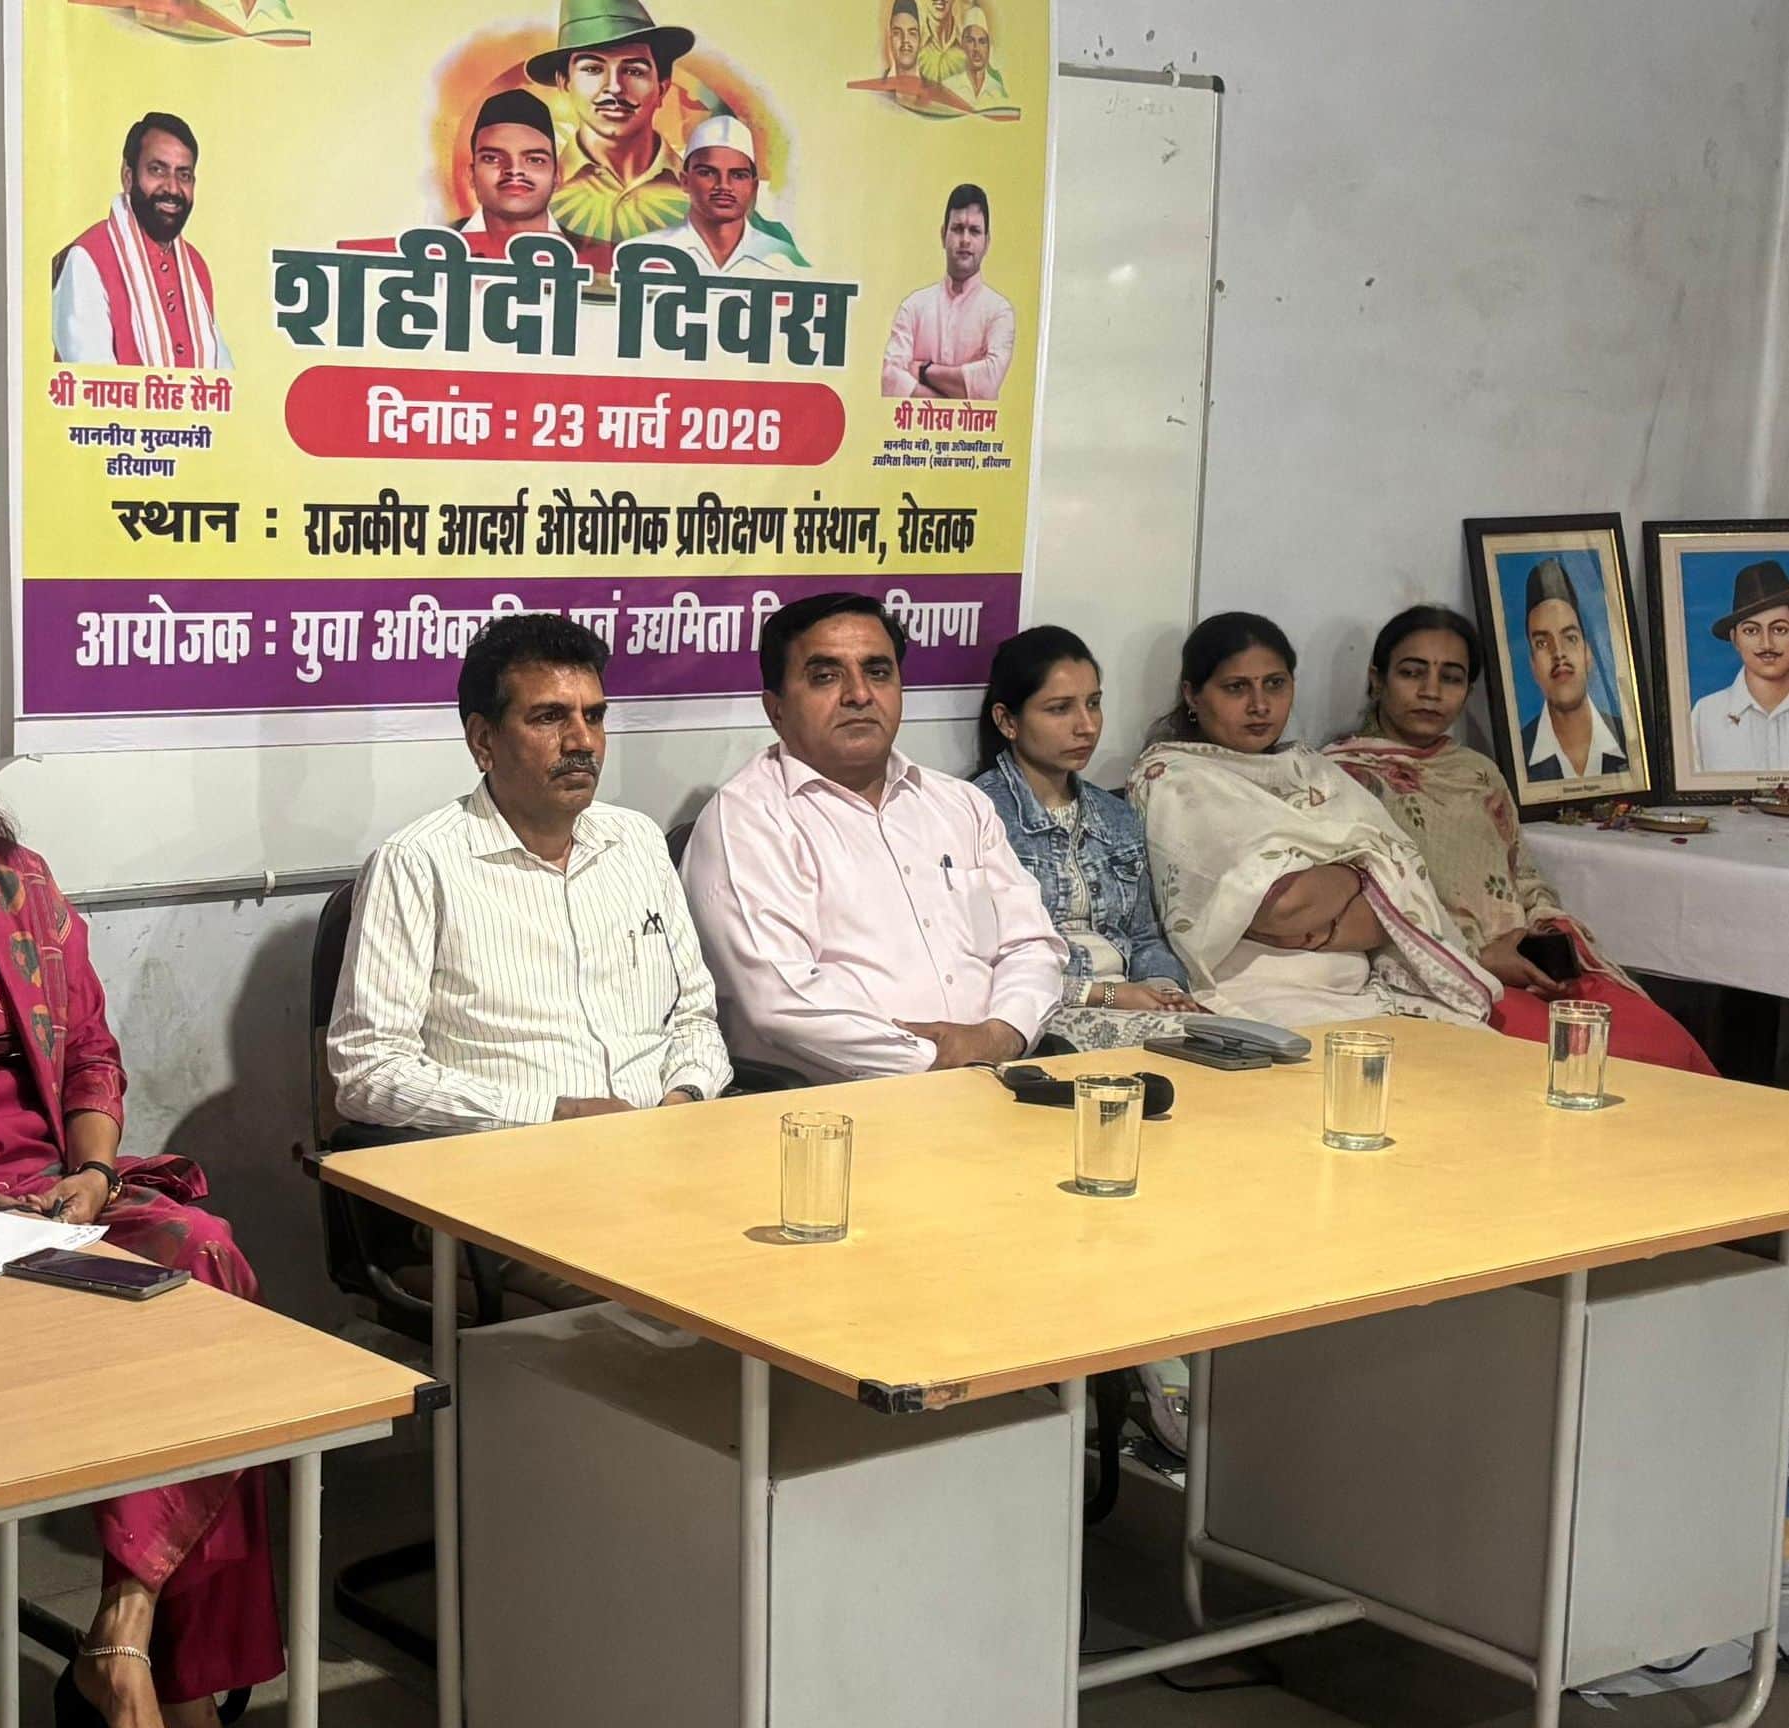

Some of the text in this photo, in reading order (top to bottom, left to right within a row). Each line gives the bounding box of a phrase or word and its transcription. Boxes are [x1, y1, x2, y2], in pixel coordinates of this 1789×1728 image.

[272, 229, 859, 367] शहीदी दिवस
[49, 371, 232, 412] श्री नायब सिंह सैनी
[366, 384, 493, 446] दिनांक
[532, 403, 584, 448] 23
[598, 392, 670, 450] मार्च
[681, 407, 780, 451] 2026
[894, 400, 998, 432] श्री गौरव गौतम
[69, 423, 211, 453] माननीय मुख्यमंत्री
[106, 454, 175, 476] हरियाणा
[112, 500, 239, 543] स्थान
[304, 488, 429, 555] राजकीय
[438, 488, 529, 555] आदर्श
[536, 488, 670, 555] औद्योगिक
[675, 492, 787, 558] प्रशिक्षण
[794, 490, 887, 565] संस्थान,
[898, 492, 977, 554] रोहतक
[76, 594, 252, 665] आयोजक
[290, 609, 364, 683] युवा
[626, 591, 744, 655] उद्यमिता
[882, 588, 984, 648] रियाणा
